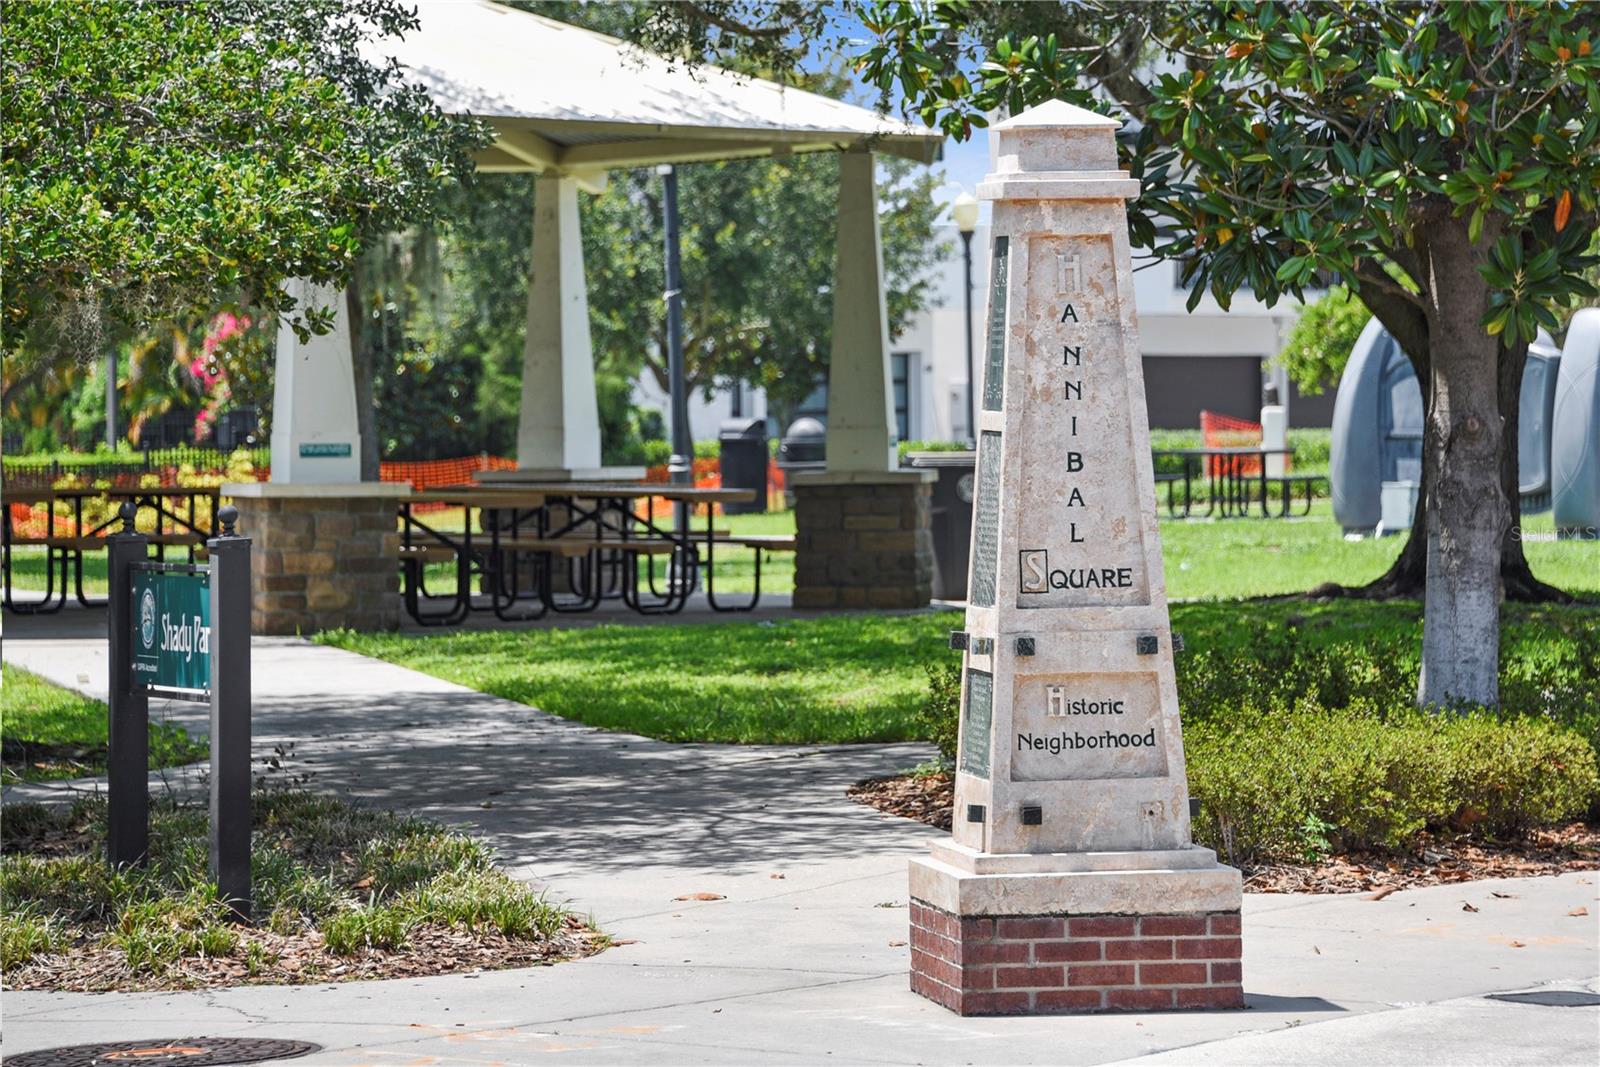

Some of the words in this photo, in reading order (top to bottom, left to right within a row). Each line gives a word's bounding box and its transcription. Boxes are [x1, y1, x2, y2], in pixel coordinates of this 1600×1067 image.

[1057, 254, 1085, 543] HANNIBAL
[1022, 550, 1132, 592] SQUARE
[161, 613, 192, 662] Shady
[195, 616, 211, 653] Par
[1046, 685, 1124, 718] Historic
[1018, 728, 1156, 755] Neighborhood
